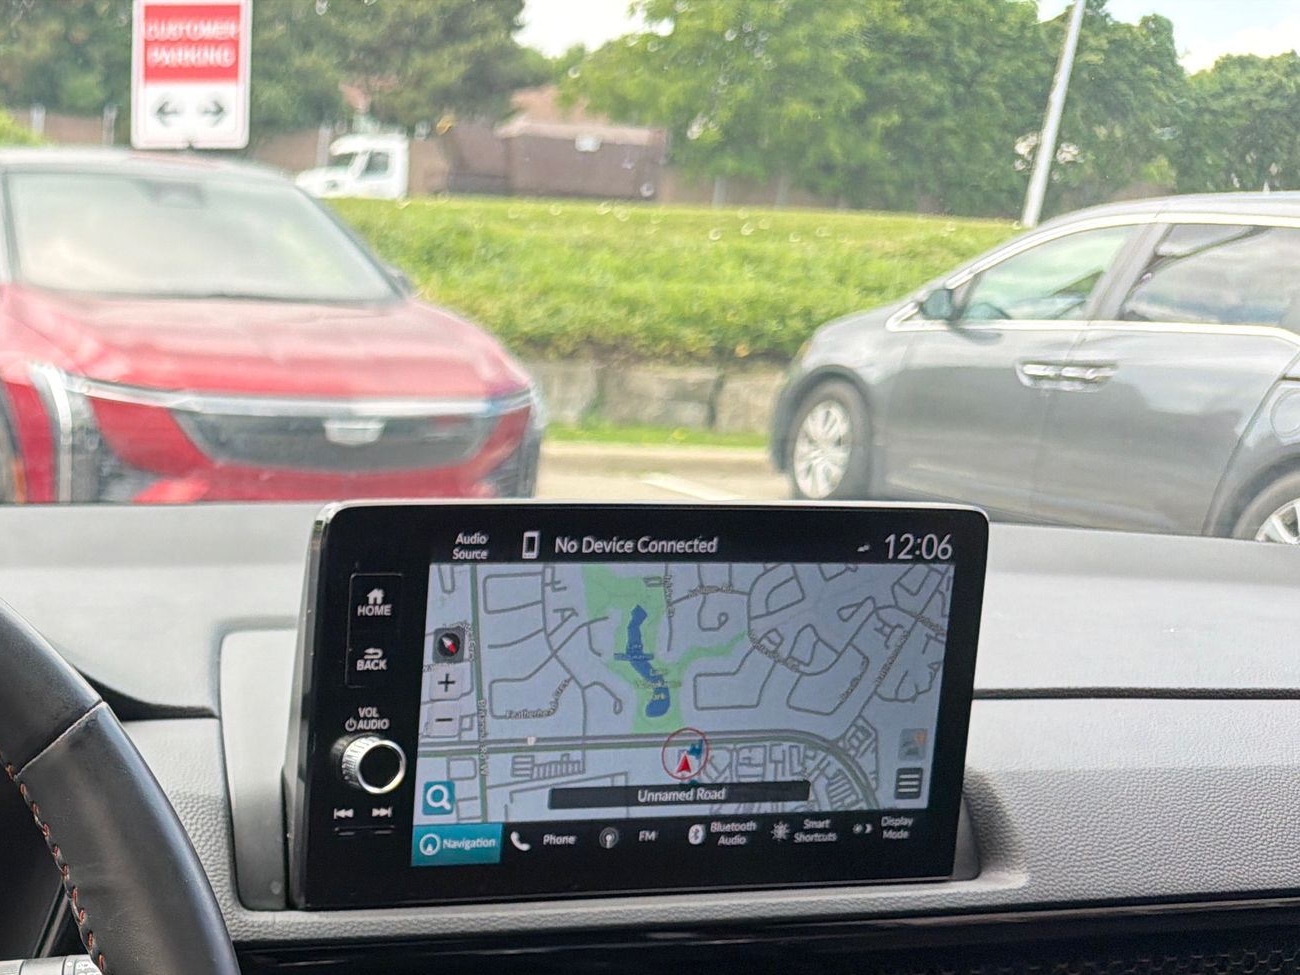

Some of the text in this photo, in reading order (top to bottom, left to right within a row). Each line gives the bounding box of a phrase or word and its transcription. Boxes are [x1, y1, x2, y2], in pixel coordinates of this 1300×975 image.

[146, 19, 238, 40] CUSTOMER
[147, 44, 237, 67] PARKING
[455, 532, 488, 545] Audio
[555, 536, 719, 554] No Device Connected
[884, 534, 953, 560] 12:06
[452, 548, 488, 560] Source
[357, 605, 392, 617] HOME
[356, 659, 387, 671] BACK
[358, 707, 379, 718] VOL
[357, 718, 390, 730] AUDIO
[637, 787, 727, 803] Unnamed Road
[710, 822, 757, 833] Bluetooth
[803, 819, 831, 830] Smart
[881, 816, 914, 829] Display
[543, 833, 576, 845] Phone
[638, 831, 657, 842] FM
[718, 835, 747, 846] Audio
[793, 831, 838, 843] Shortcuts
[882, 829, 910, 841] Mode
[443, 837, 496, 850] Navigation
